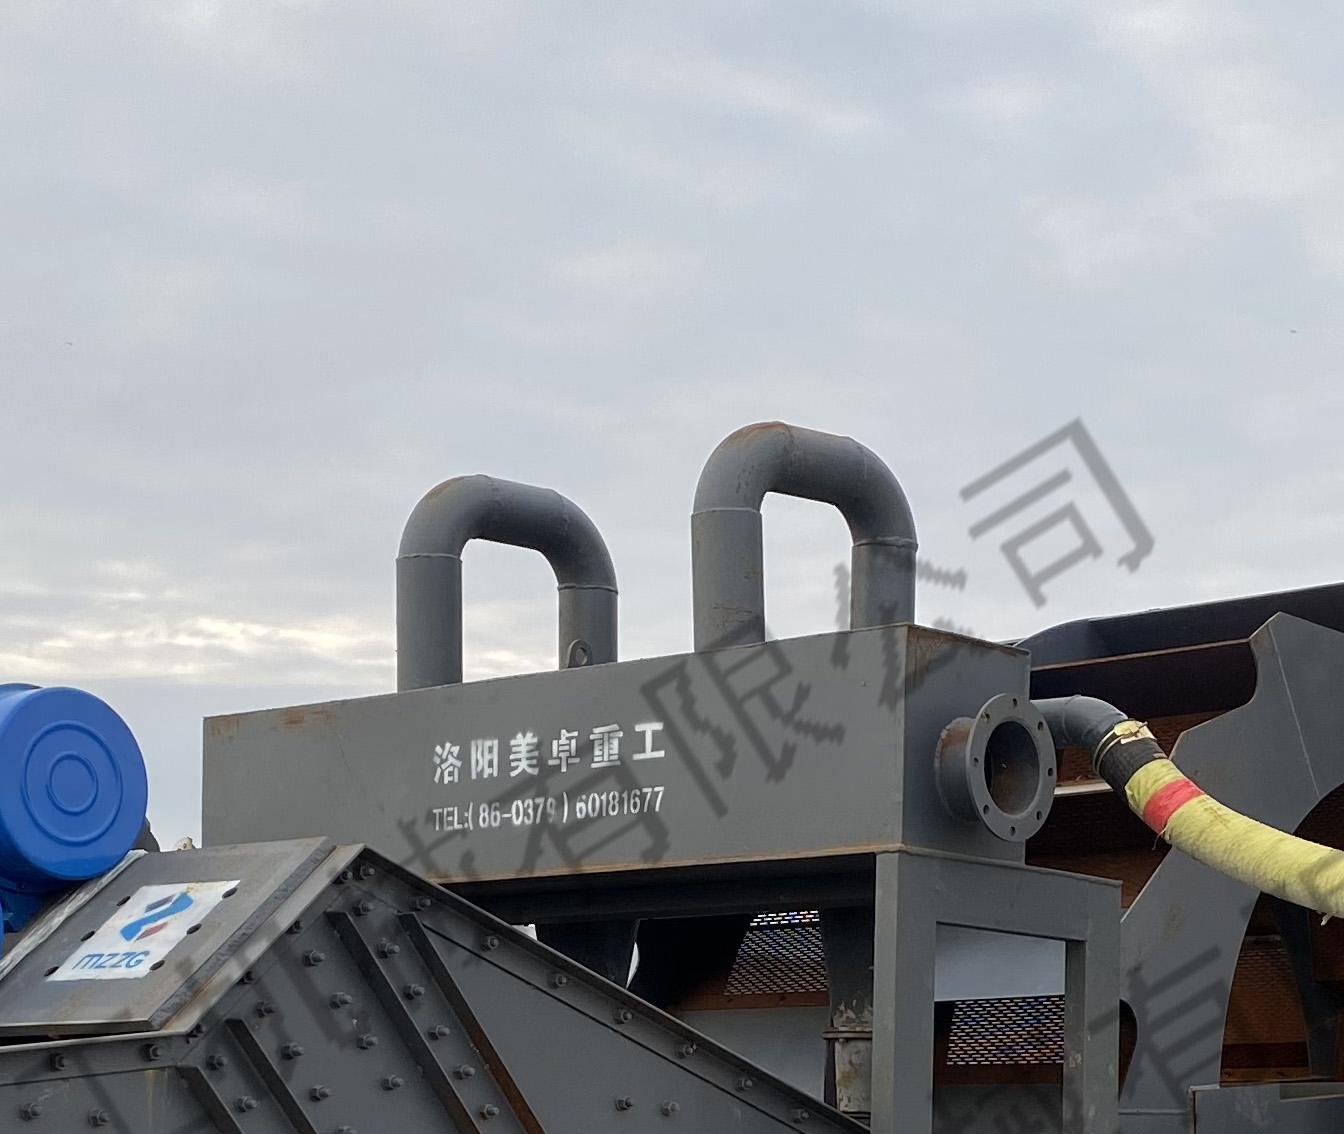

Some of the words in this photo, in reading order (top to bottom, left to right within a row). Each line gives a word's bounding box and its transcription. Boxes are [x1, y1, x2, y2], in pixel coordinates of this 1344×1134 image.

[432, 721, 666, 785] 洛阳美卓重工
